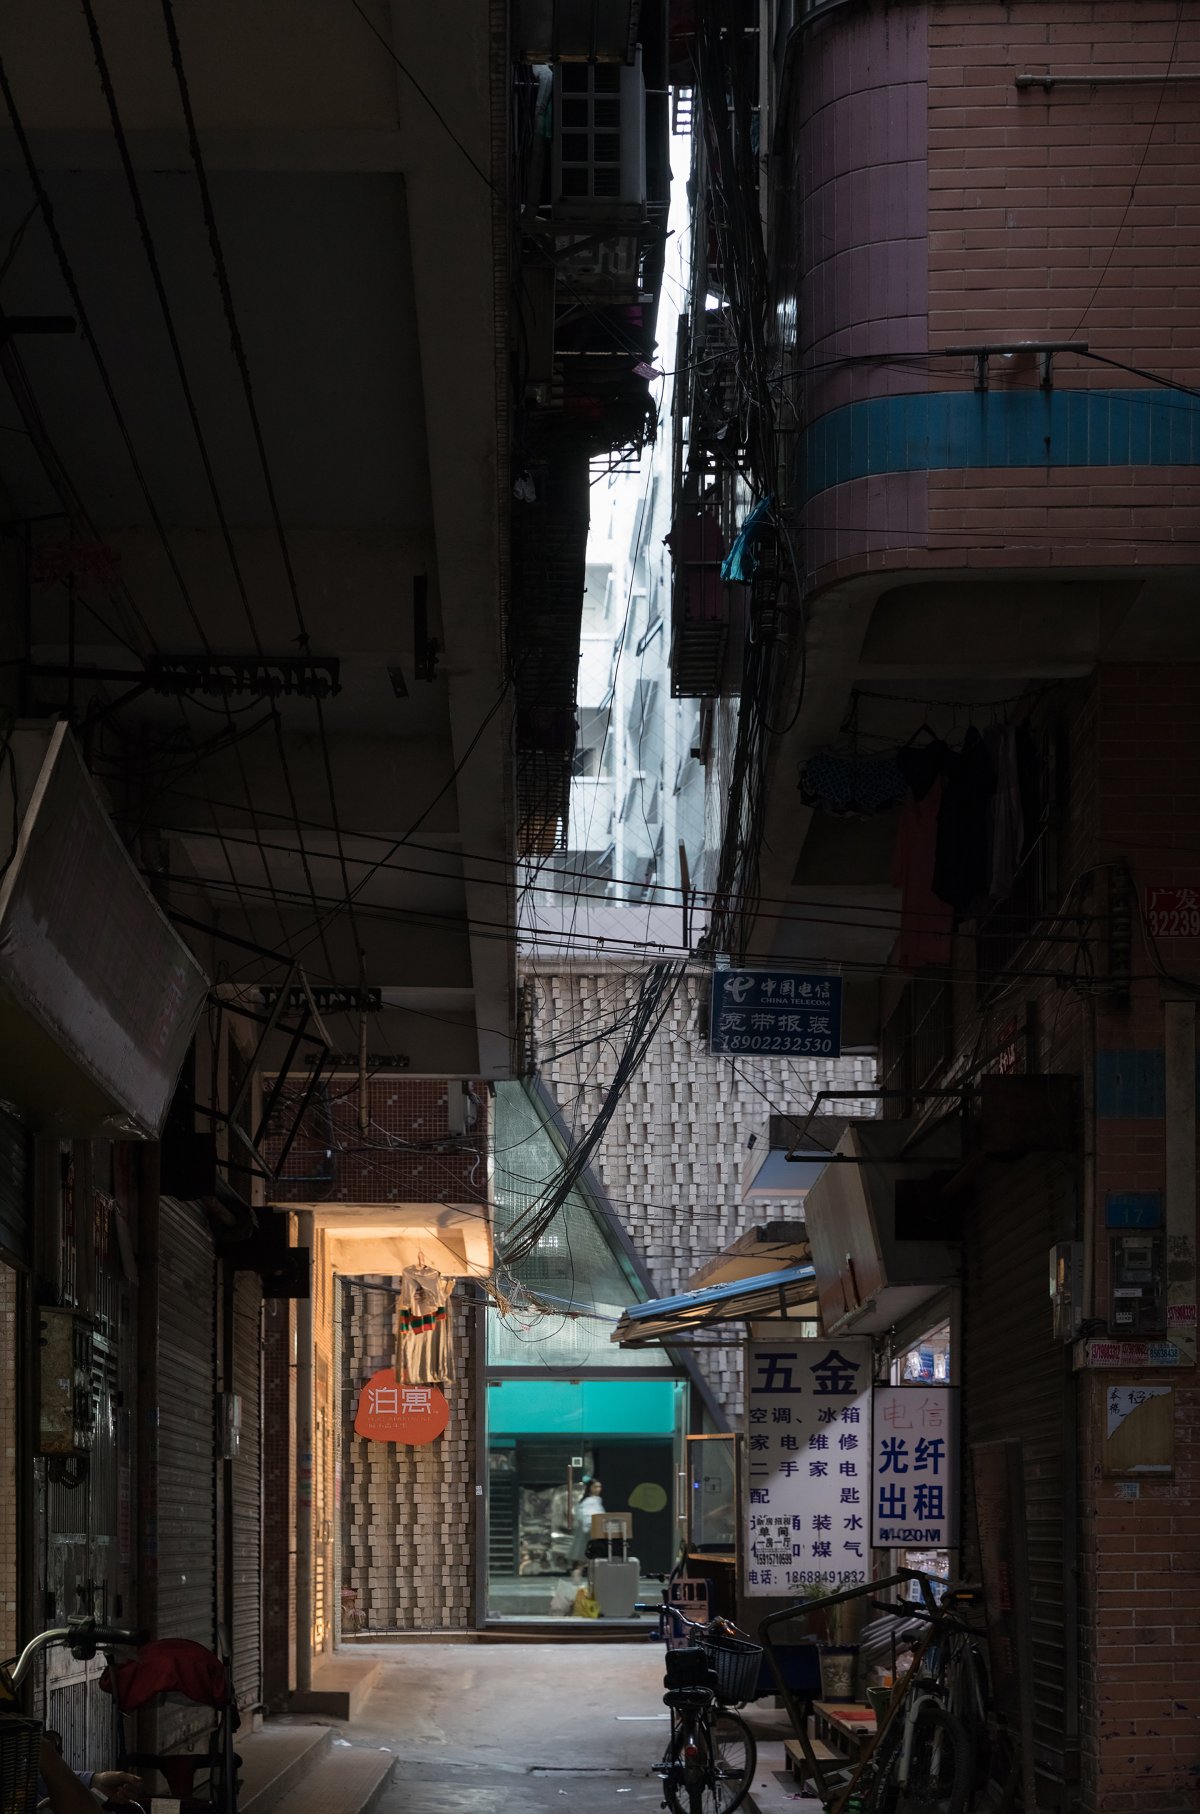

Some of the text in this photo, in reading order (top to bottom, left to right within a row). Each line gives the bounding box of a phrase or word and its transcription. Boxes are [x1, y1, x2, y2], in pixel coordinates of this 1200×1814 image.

[761, 978, 831, 998] 中国电信
[791, 998, 831, 1006] TELECOM
[720, 1012, 832, 1034] 宽带报装
[721, 1034, 832, 1052] 18902232530
[751, 1350, 861, 1395] 五金
[749, 1406, 861, 1424] 空调、冰箱
[883, 1398, 945, 1429] 电信
[750, 1433, 859, 1450] 家电维修
[878, 1436, 945, 1475] 光纤
[751, 1461, 858, 1477] 二手家电
[878, 1483, 945, 1521] 出租
[759, 1526, 789, 1537] 单间
[757, 1537, 791, 1548] 一房一厅
